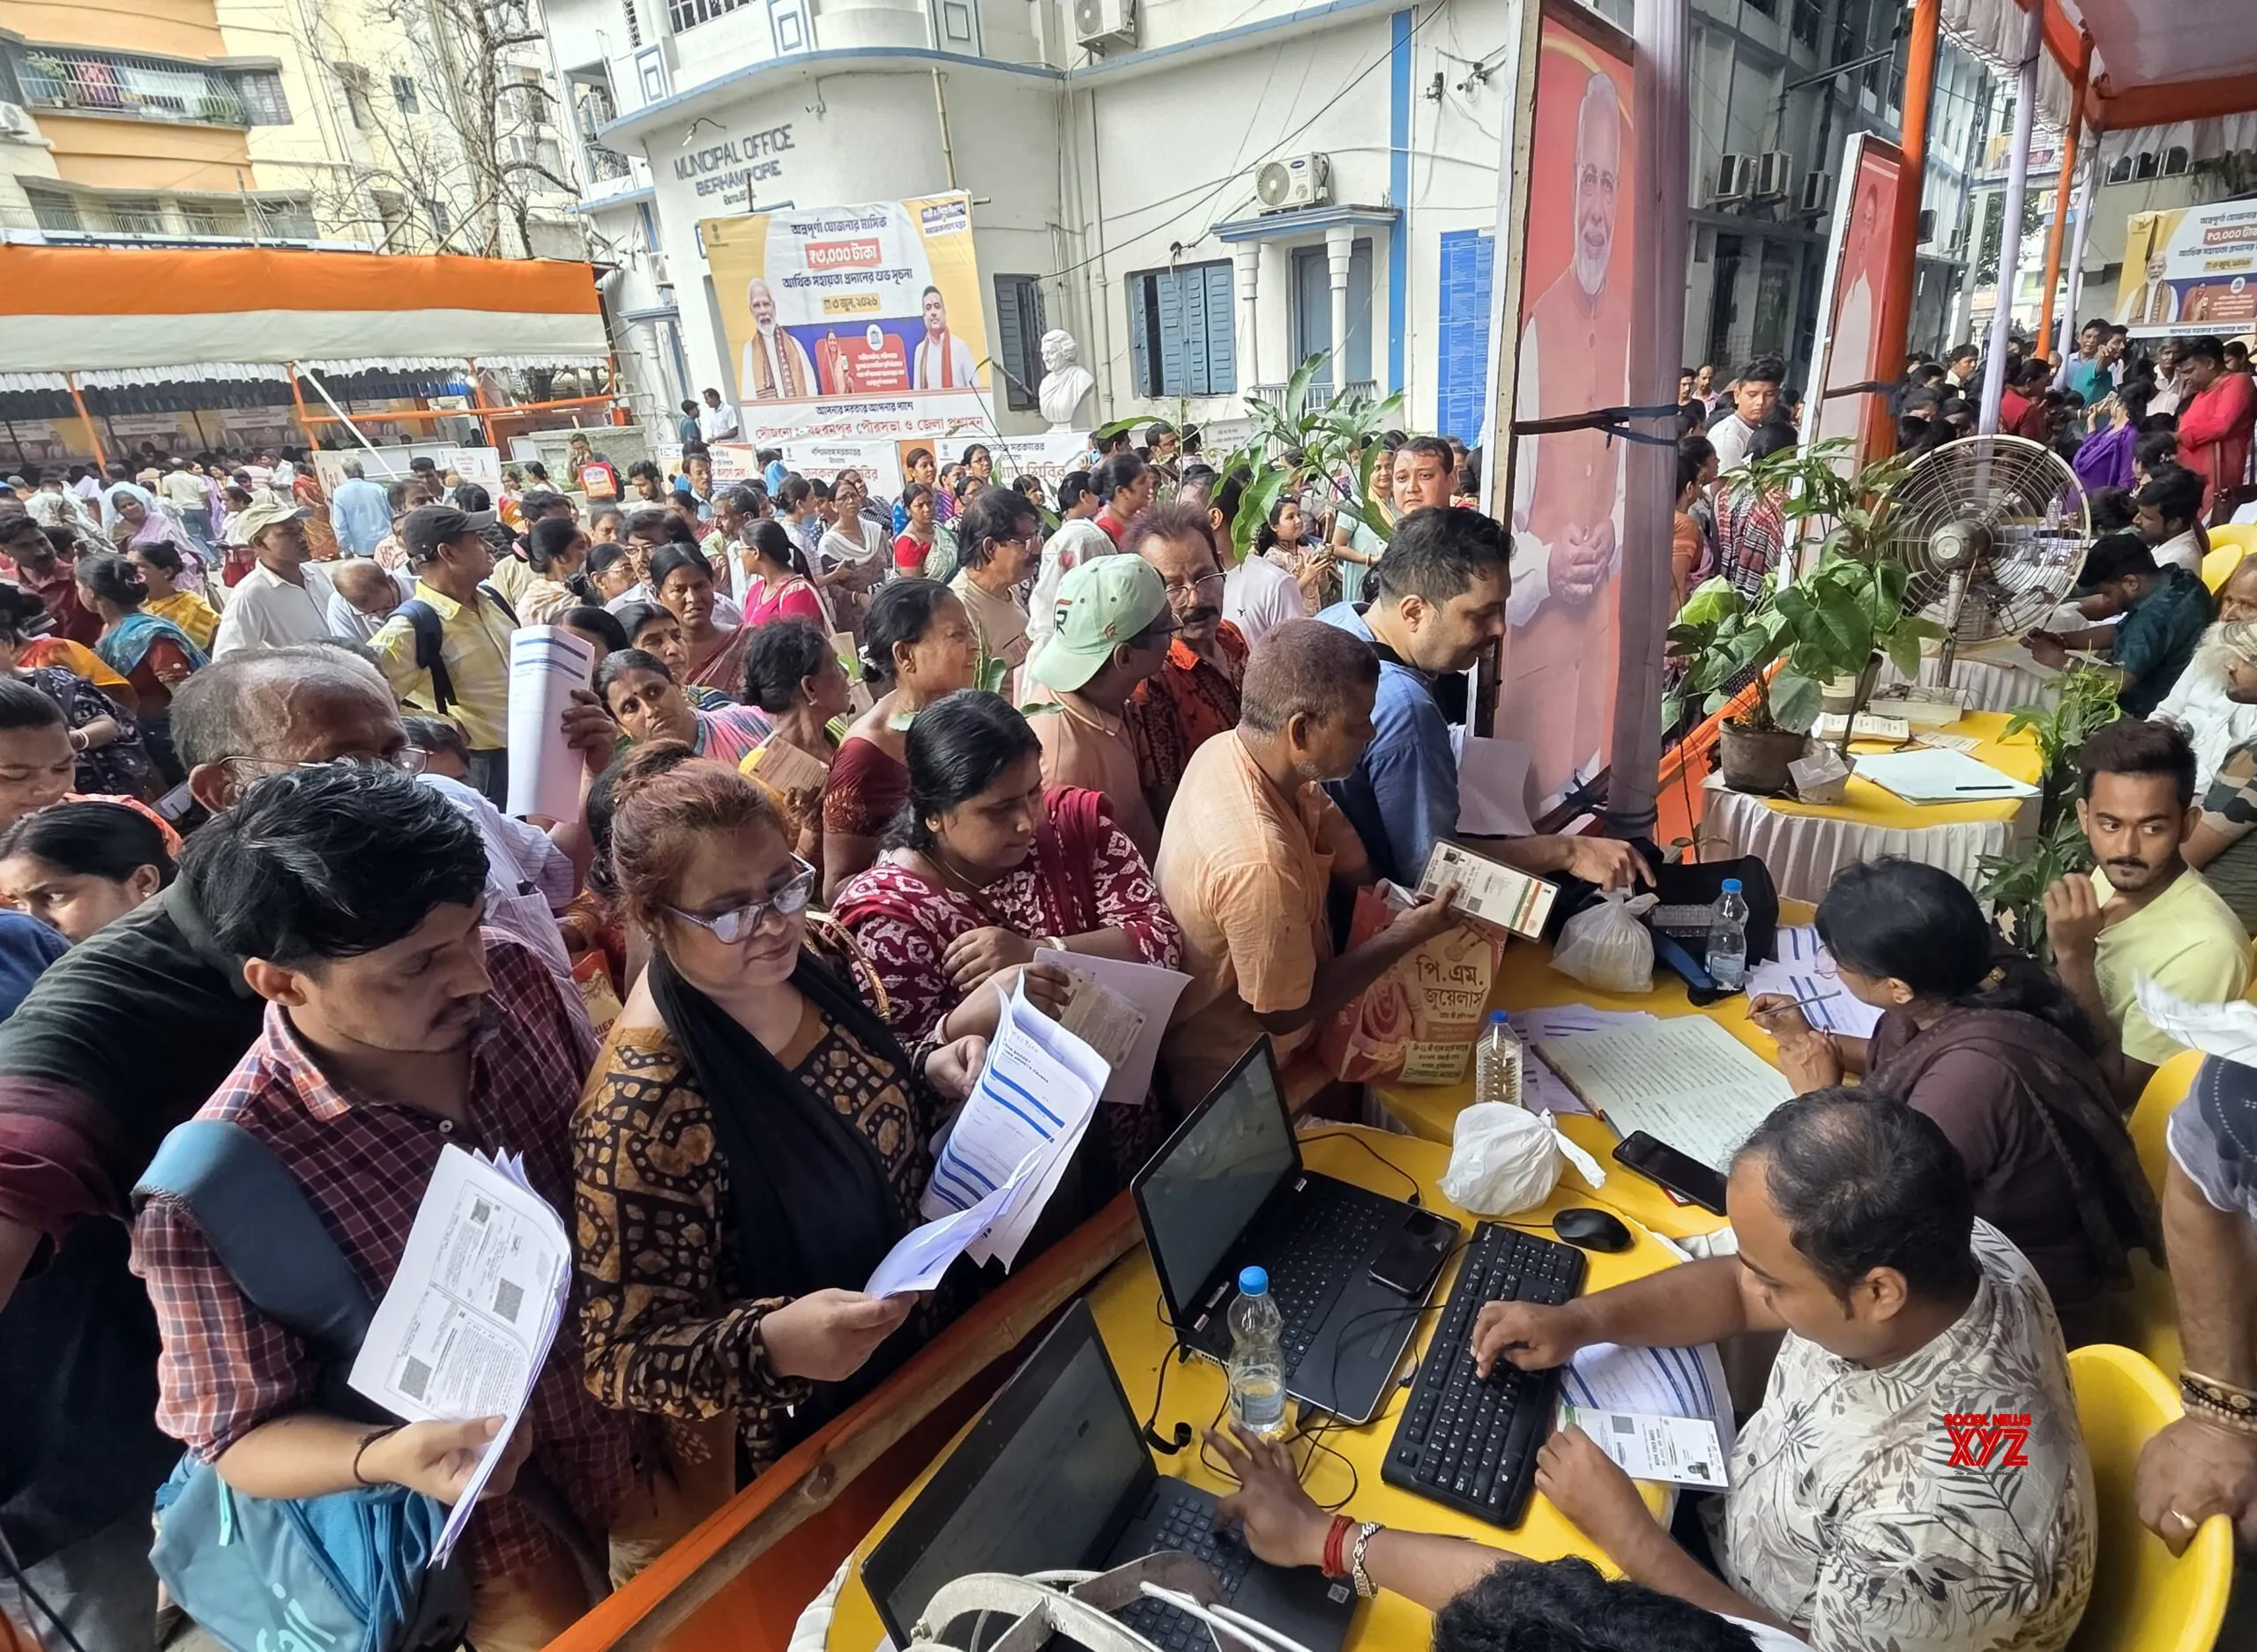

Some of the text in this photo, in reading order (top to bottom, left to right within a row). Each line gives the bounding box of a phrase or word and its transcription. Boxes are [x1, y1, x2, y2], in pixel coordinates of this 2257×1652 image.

[674, 123, 795, 180] MUNICIPAL OFFICE
[696, 160, 782, 197] BERHAMPORE
[860, 214, 887, 229] মাসিক
[851, 242, 877, 260] টাকা
[782, 272, 811, 288] আর্থিক
[892, 268, 913, 285] সূচনা
[806, 422, 853, 438] বহরমপুর
[857, 420, 901, 434] পৌরসভা
[905, 420, 913, 430] ও
[919, 419, 944, 431] জেলা
[1415, 953, 1484, 986] পি.এম.
[1422, 986, 1488, 1011] জুয়েলার্স
